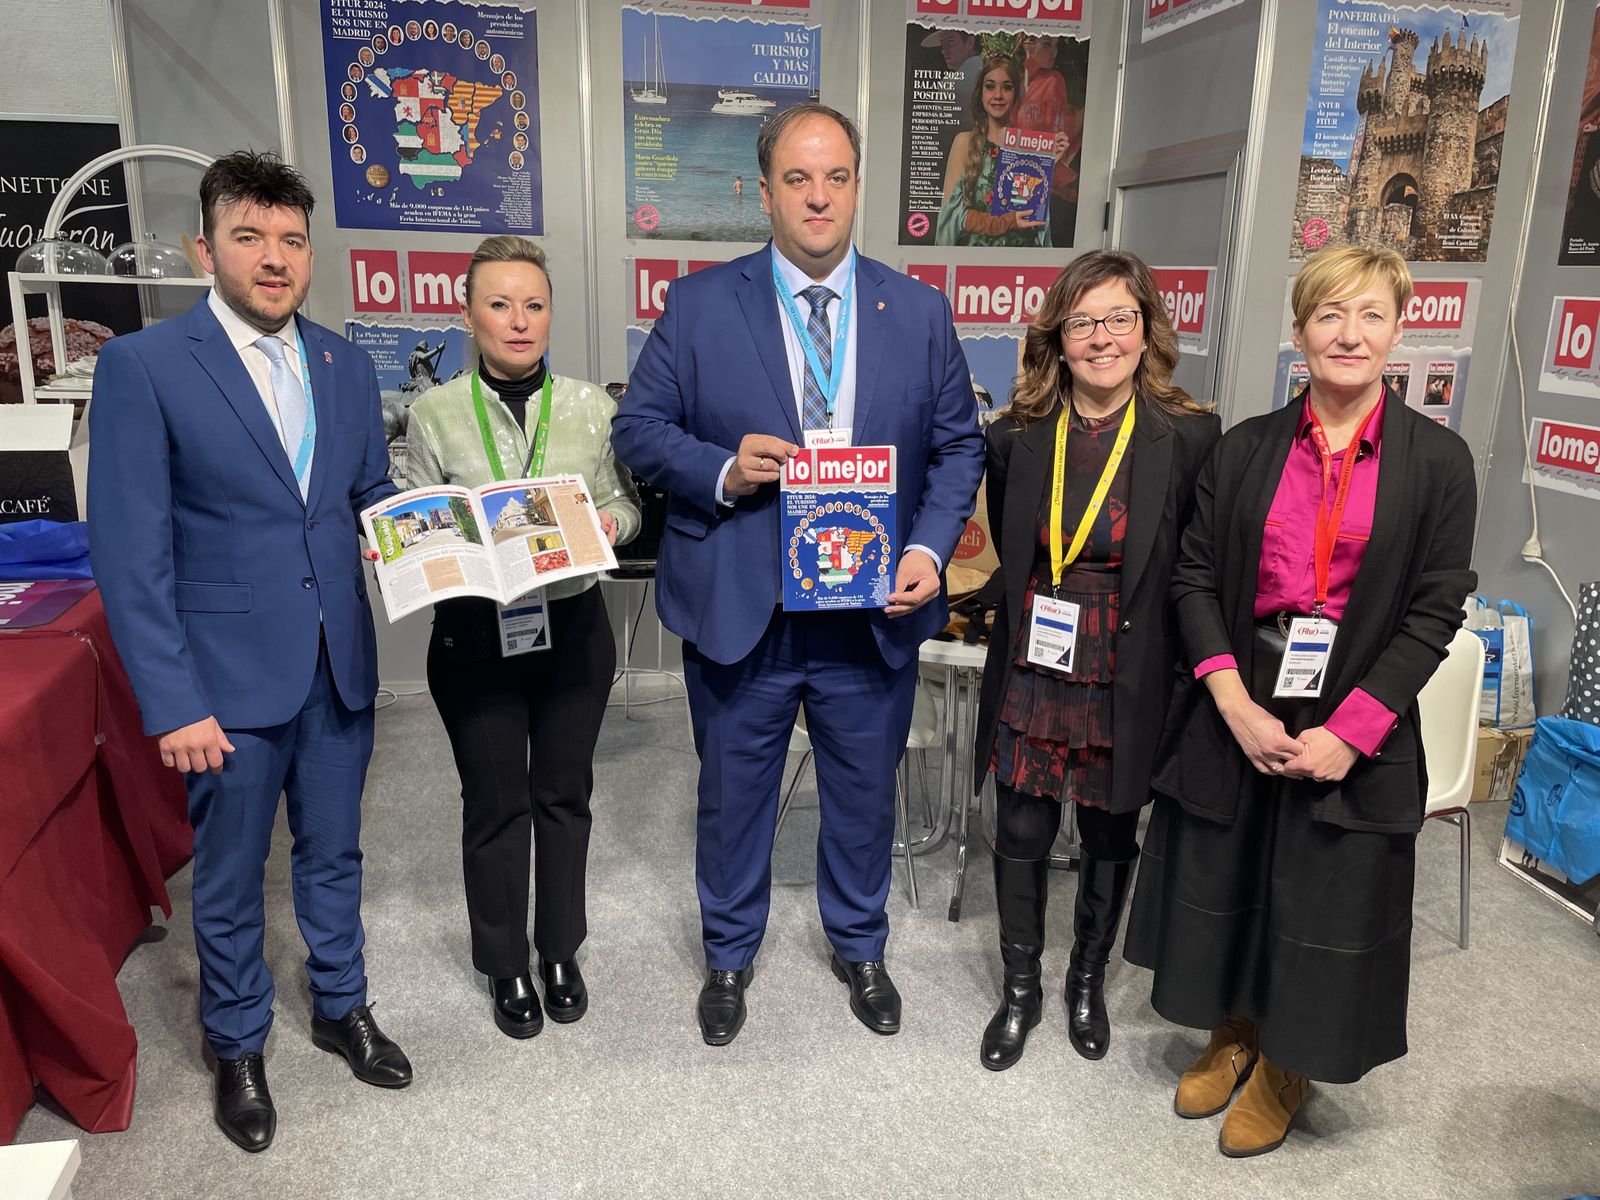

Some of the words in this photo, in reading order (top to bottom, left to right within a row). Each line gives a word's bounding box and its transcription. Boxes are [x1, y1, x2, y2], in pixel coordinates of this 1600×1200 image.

[331, 0, 361, 8] FITUR
[364, 0, 386, 9] 2024:
[332, 8, 344, 17] EL
[345, 9, 388, 19] TURISMO
[477, 12, 505, 20] Mensajes
[1328, 10, 1400, 24] PONFERRADA:
[332, 19, 350, 27] NOS
[353, 19, 372, 28] UNE
[375, 21, 387, 29] EN
[490, 21, 523, 29] presidentes
[333, 28, 370, 37] MADRID
[1327, 23, 1338, 35] El
[1341, 26, 1380, 37] encanto
[784, 29, 809, 44] MÁS
[1325, 38, 1341, 49] del
[1344, 39, 1381, 51] Interior
[752, 44, 809, 58] TURISMO
[773, 60, 782, 70] Y
[784, 56, 808, 71] MÁS
[754, 72, 808, 85] CALIDAD
[914, 69, 942, 79] FITUR
[943, 71, 964, 80] 2023
[913, 80, 955, 90] BALANCE
[913, 91, 955, 101] POSITIVO
[1318, 101, 1340, 109] INTUR
[1005, 129, 1015, 146] lo
[1020, 131, 1053, 150] mejor
[356, 260, 395, 304] lo
[957, 275, 1051, 324] mejo
[1559, 312, 1592, 359] lo
[1437, 364, 1453, 373] mejor
[816, 437, 830, 445] Fitur
[788, 456, 810, 480] lo
[819, 454, 888, 484] mejor
[1044, 606, 1057, 614] Fitur
